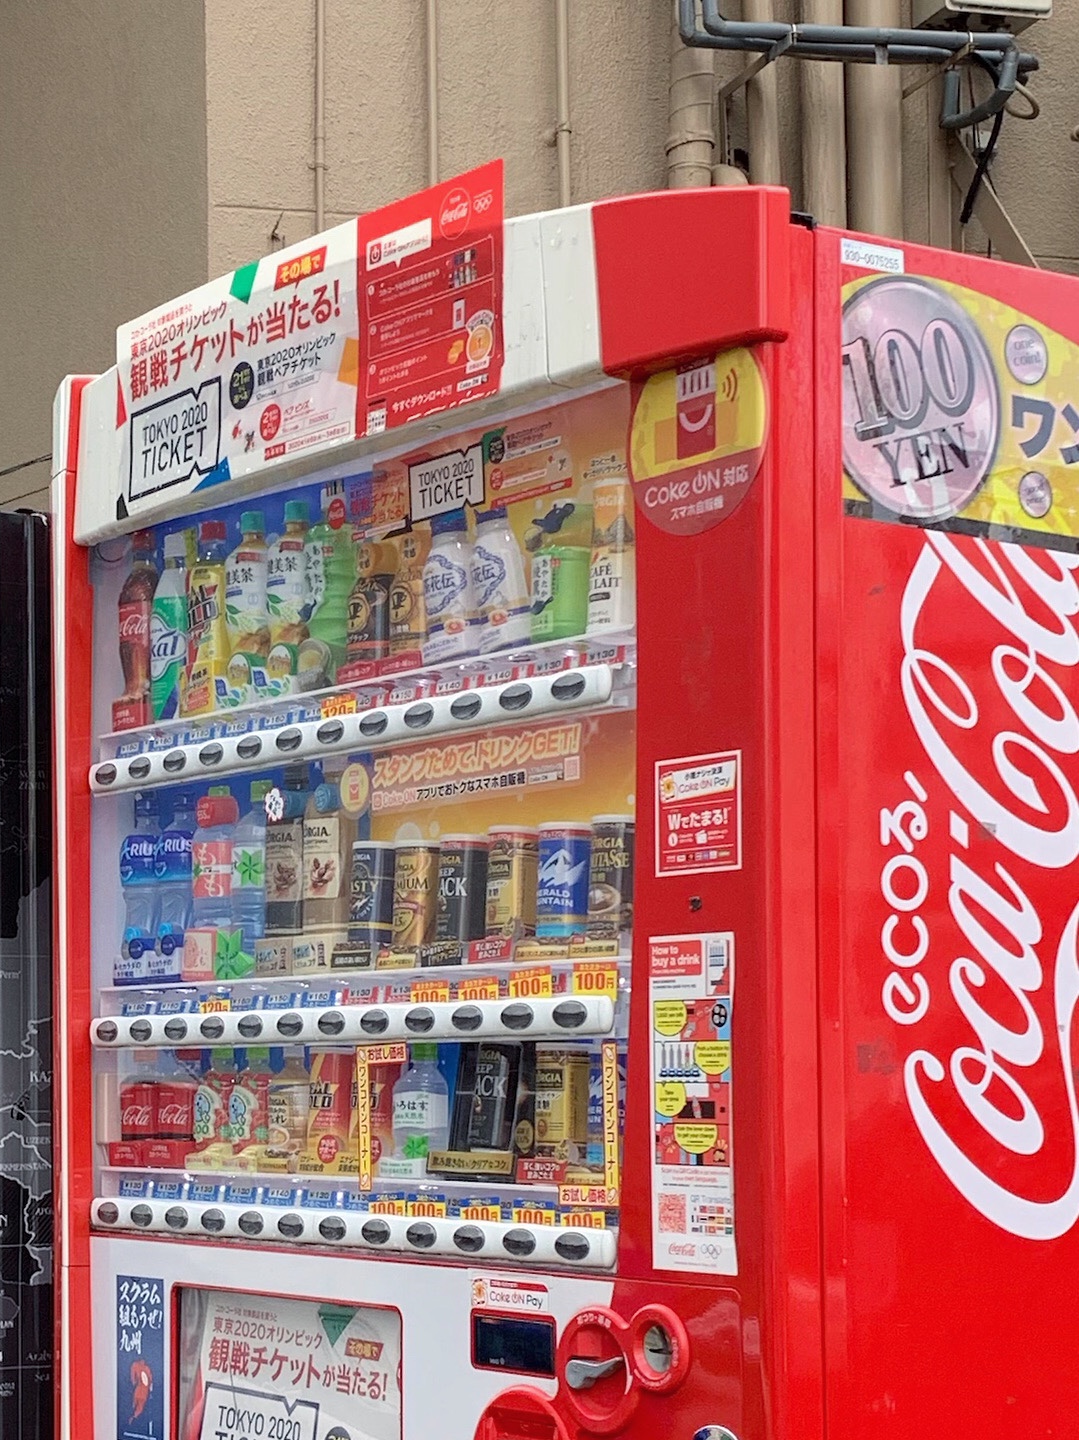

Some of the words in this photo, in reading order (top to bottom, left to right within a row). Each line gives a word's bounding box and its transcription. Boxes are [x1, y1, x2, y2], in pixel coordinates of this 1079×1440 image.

[130, 301, 228, 361] 東京2020オリンピック
[130, 279, 342, 402] 観戦チケットが当たる!
[842, 318, 975, 443] 100
[142, 410, 179, 447] TOKYO
[180, 401, 209, 433] 2020
[141, 426, 208, 479] TICKET
[872, 421, 972, 489] YEN
[418, 470, 450, 488] TOKYO
[451, 458, 475, 478] 2020
[645, 480, 690, 508] Coke
[691, 468, 721, 495] ON
[722, 464, 749, 488] 対応
[419, 474, 475, 510] TICKET
[670, 494, 725, 522] スマホ自販機
[678, 781, 699, 795] Coke
[714, 776, 731, 788] Pay
[667, 807, 729, 832] Wでたまる!
[652, 956, 669, 968] buy
[677, 954, 700, 966] drink
[511, 978, 549, 997] 100円
[574, 971, 615, 992] 100円
[366, 1045, 406, 1061] お試し価格
[358, 1066, 369, 1172] ワンコインコーナー
[603, 1065, 616, 1185] ワンコインコーナー
[561, 1188, 607, 1204] お試し価格
[119, 1282, 161, 1305] スクラム
[489, 1290, 511, 1304] Coke
[526, 1294, 544, 1310] Pay
[119, 1329, 142, 1355] 九州
[213, 1316, 323, 1350] 東京2020オリンピック
[208, 1336, 388, 1402] 観戦チケットが当たる!
[217, 1404, 265, 1436] TOKYO
